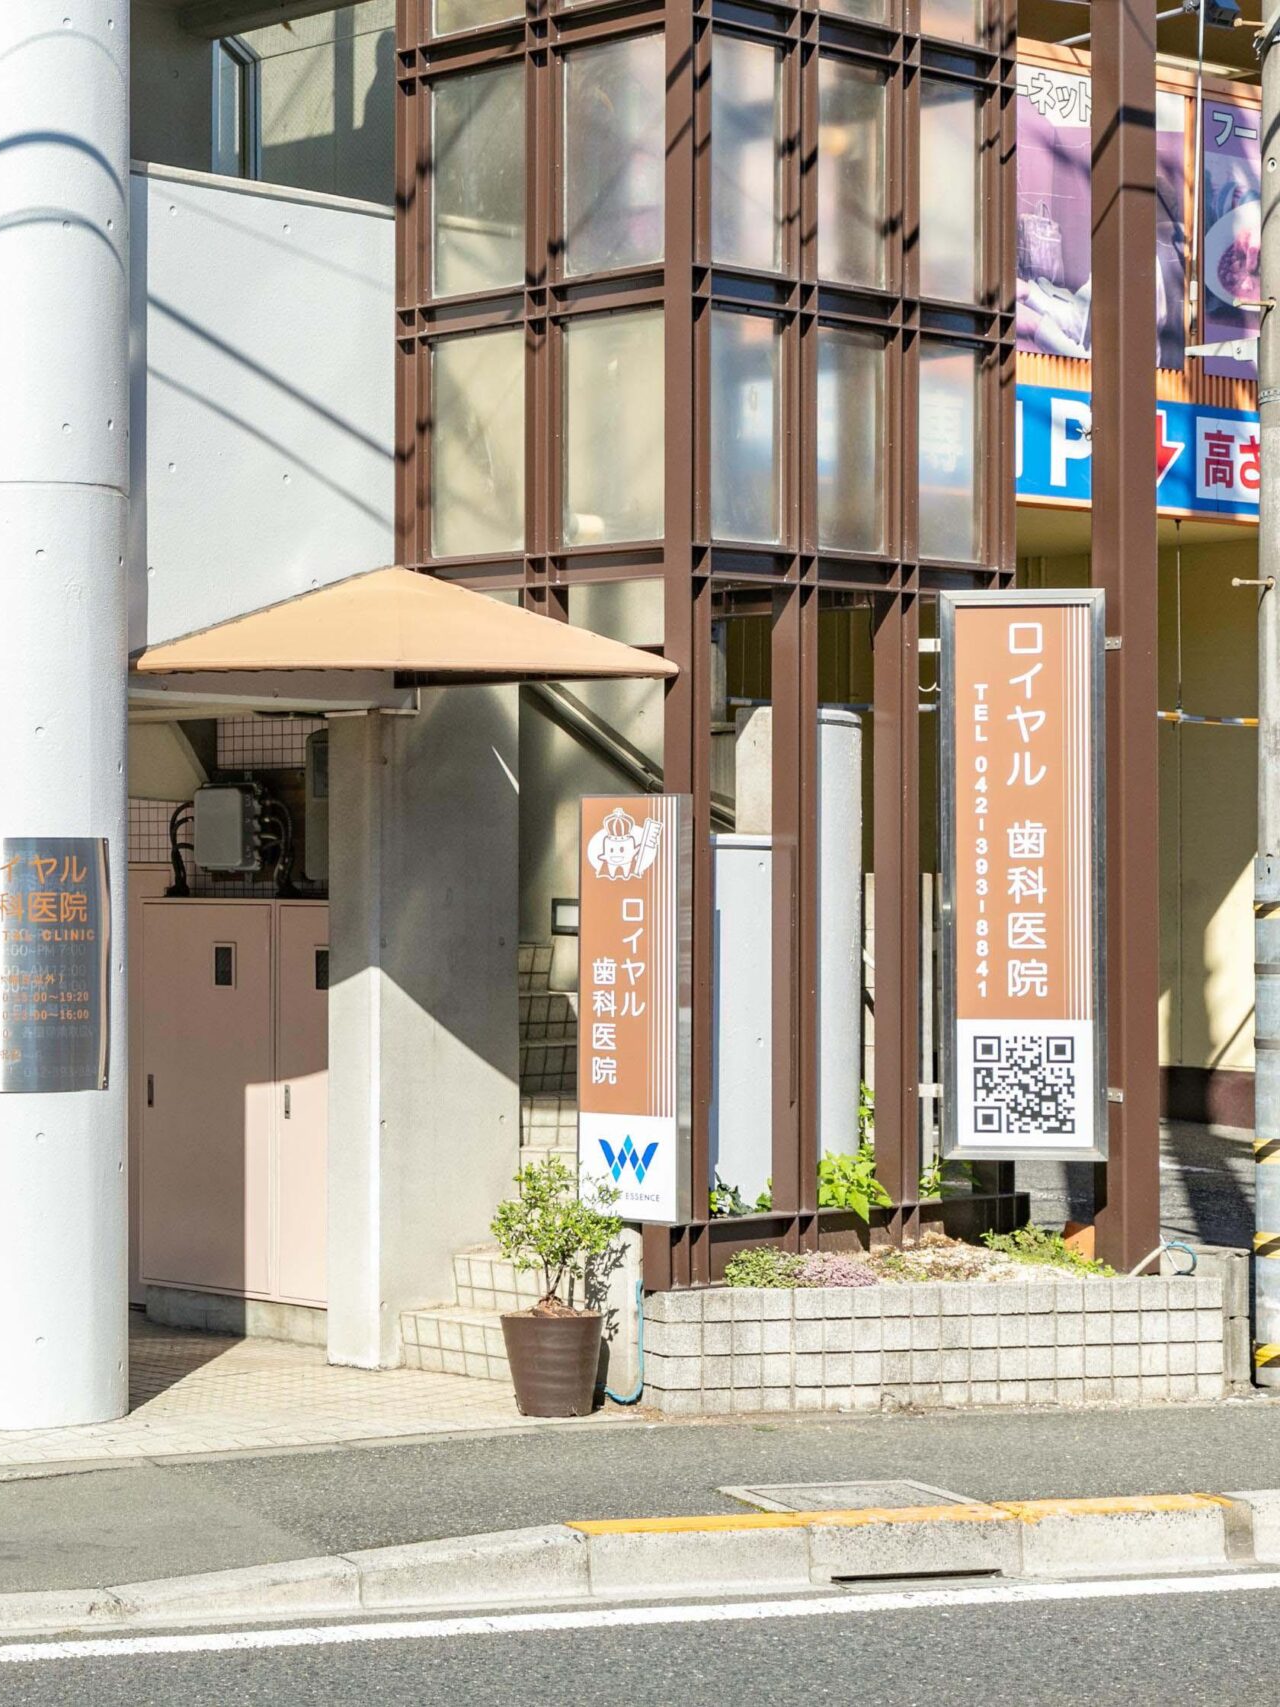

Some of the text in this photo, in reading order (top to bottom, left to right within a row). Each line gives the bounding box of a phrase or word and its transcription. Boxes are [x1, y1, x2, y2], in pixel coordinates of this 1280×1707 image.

[1212, 111, 1257, 146] フー
[974, 684, 988, 998] TEL 042-393-8841
[1007, 622, 1049, 998] ロイヤル 歯科医院
[42, 929, 95, 941] CLINIC
[621, 898, 646, 1017] ロイヤル
[592, 957, 618, 1085] 歯科医院
[625, 1192, 660, 1202] ESSENCE
